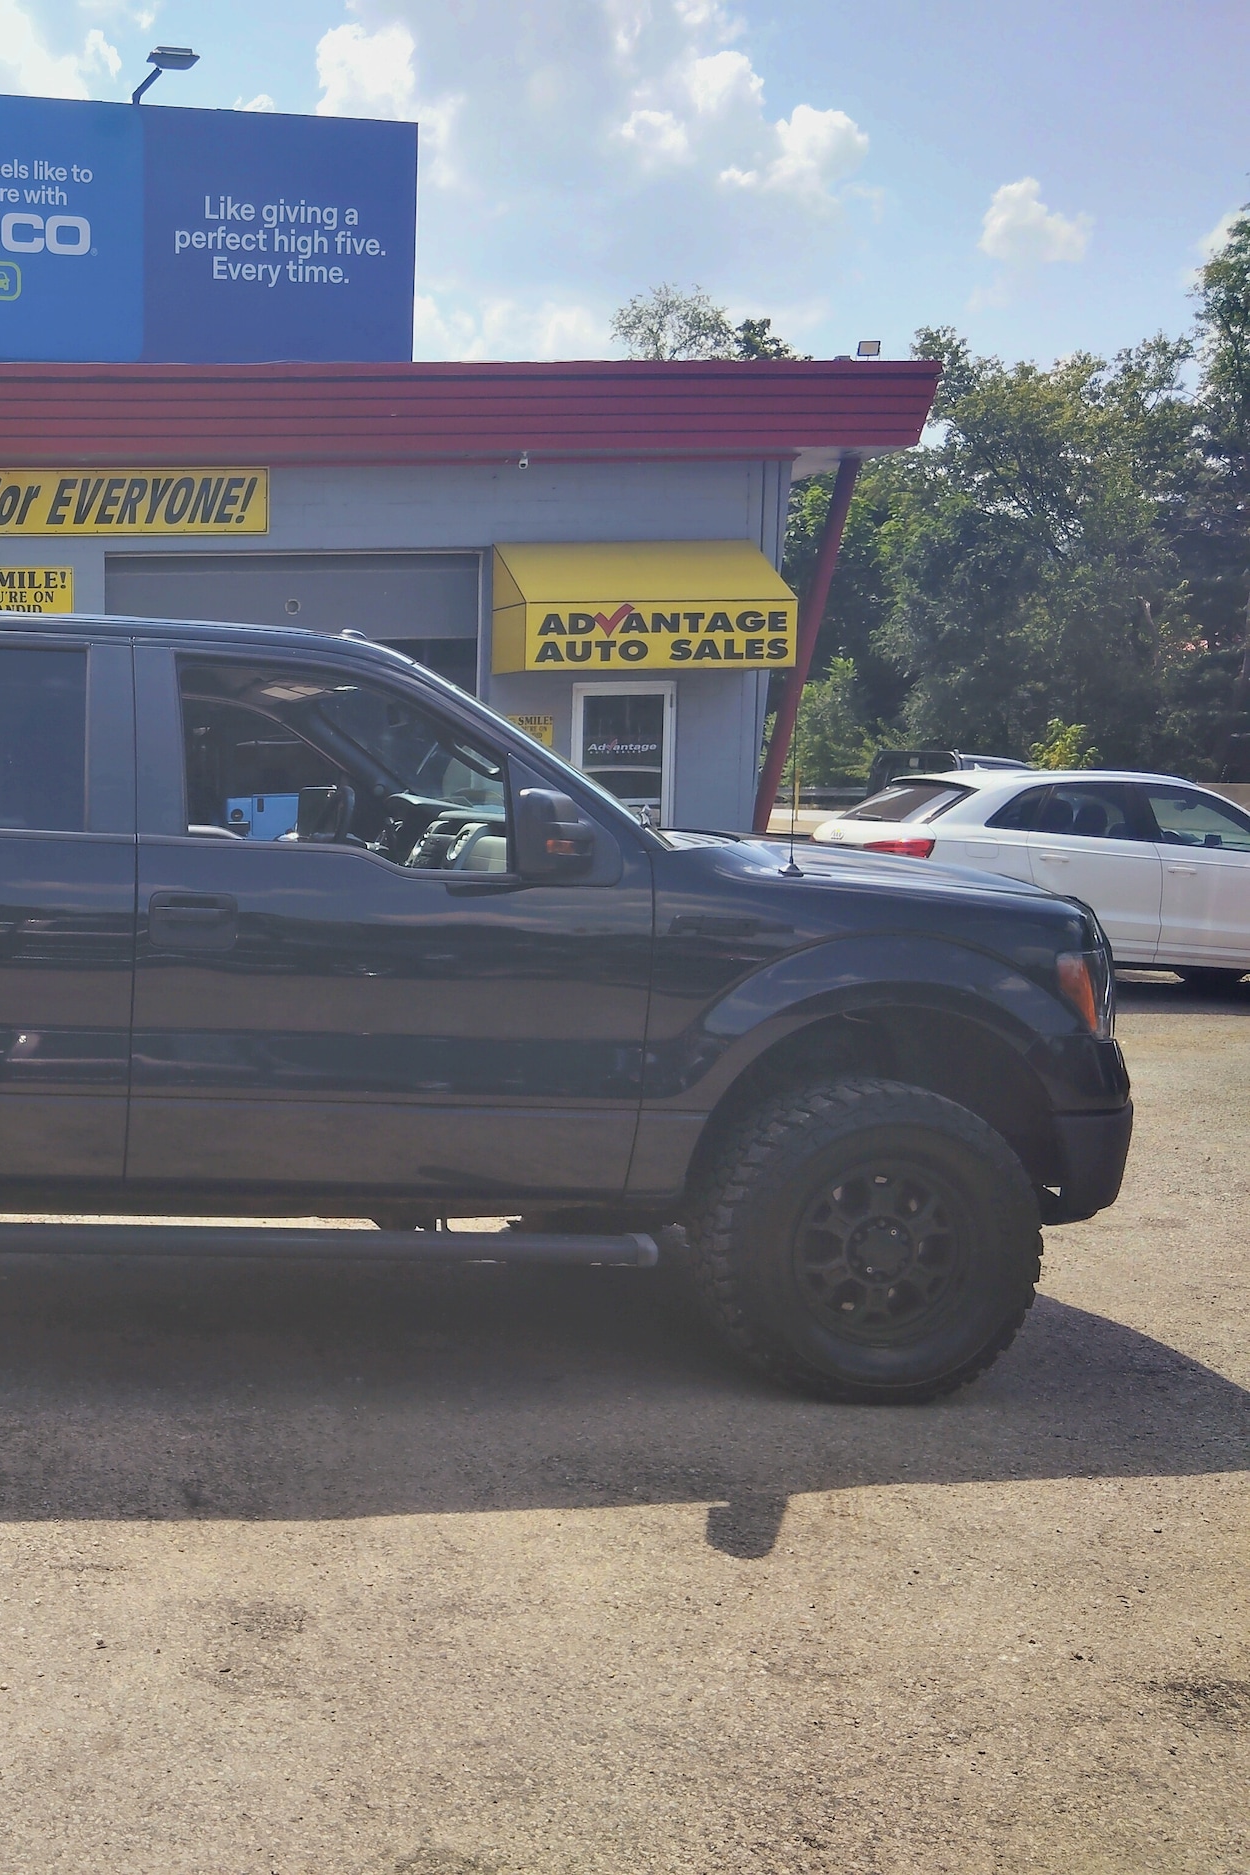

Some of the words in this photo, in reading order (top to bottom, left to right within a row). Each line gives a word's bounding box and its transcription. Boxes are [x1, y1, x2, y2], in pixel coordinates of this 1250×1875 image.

[33, 160, 68, 182] like
[71, 164, 93, 183] to
[23, 185, 68, 206] with
[204, 195, 256, 221] Like
[262, 198, 338, 231] giving
[344, 207, 359, 226] a
[174, 226, 268, 254] perfect
[274, 228, 329, 259] high
[334, 231, 386, 256] five.
[212, 256, 281, 288] Every
[286, 259, 350, 284] time.
[46, 476, 258, 525] EVERYONE!
[33, 591, 54, 603] ON
[537, 604, 788, 637] ADVANTAGE
[534, 639, 648, 662] AUTO
[669, 638, 788, 661] SALES
[518, 716, 553, 726] SMILE!
[587, 739, 657, 752] Advantage
